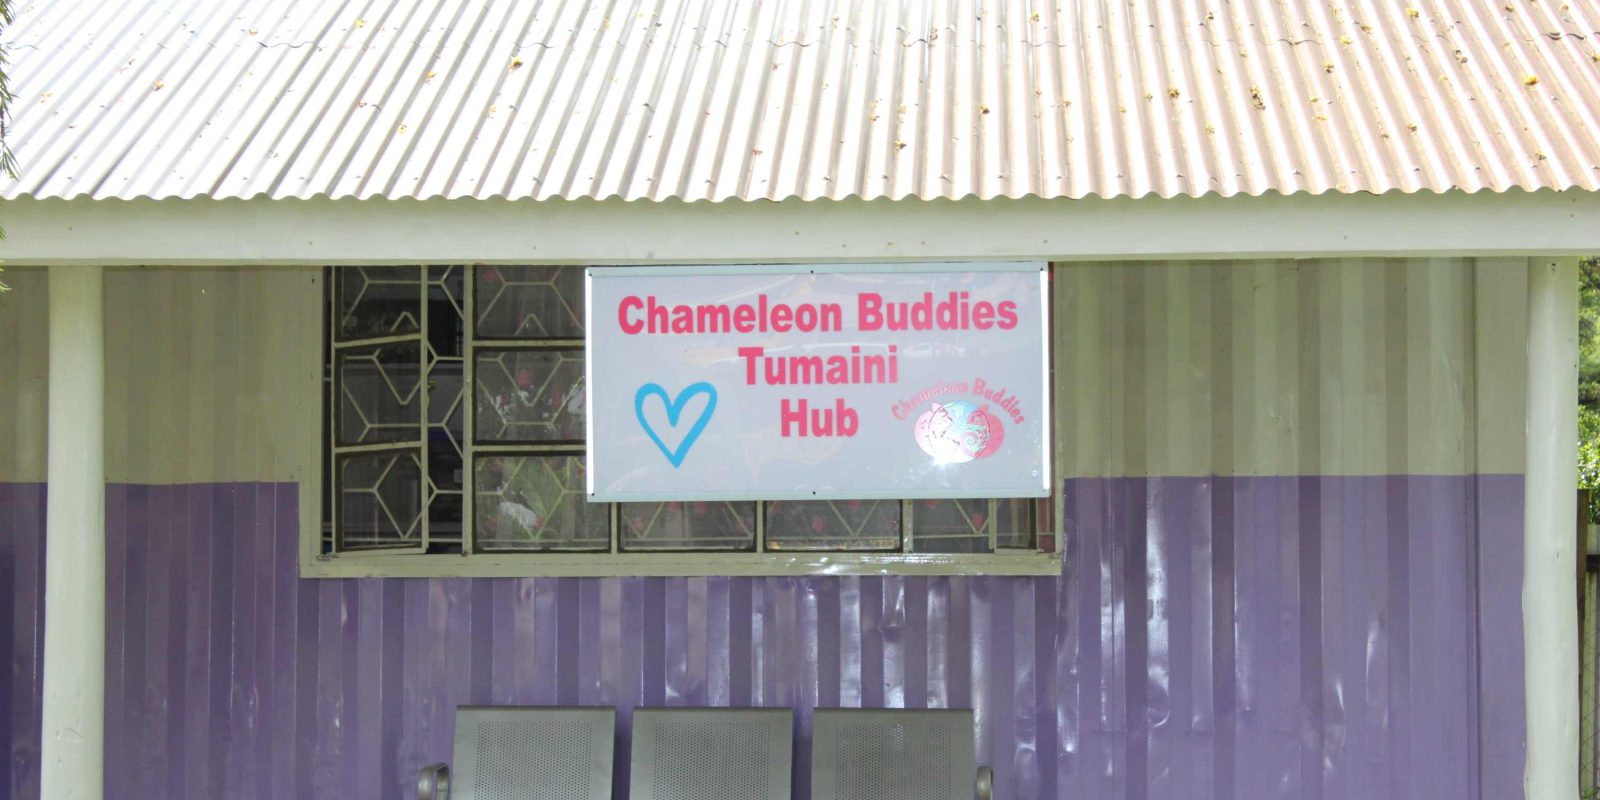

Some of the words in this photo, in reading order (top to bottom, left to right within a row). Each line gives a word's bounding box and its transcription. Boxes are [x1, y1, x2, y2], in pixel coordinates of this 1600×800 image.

[618, 295, 842, 335] Chameleon
[858, 292, 1018, 332] Buddies
[738, 346, 898, 386] Tumaini
[780, 399, 859, 438] Hub
[891, 378, 969, 420] Chameleon
[972, 377, 1025, 424] Buddies
